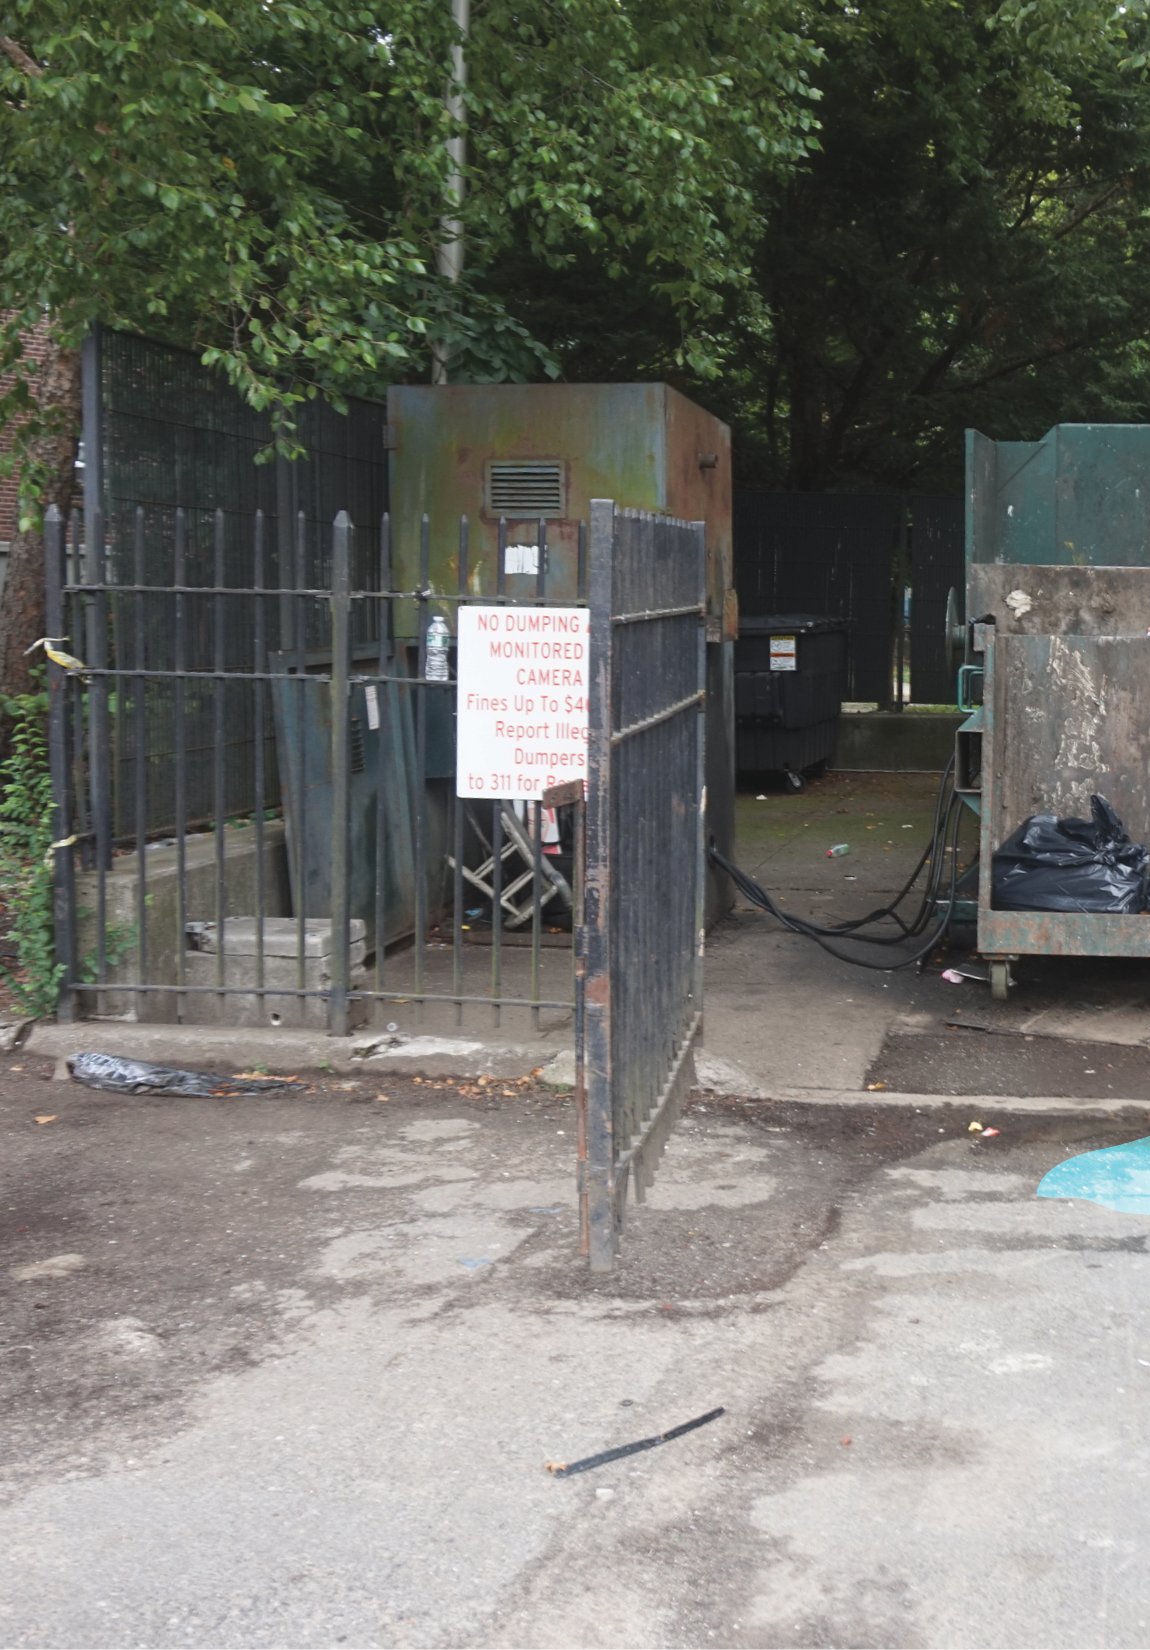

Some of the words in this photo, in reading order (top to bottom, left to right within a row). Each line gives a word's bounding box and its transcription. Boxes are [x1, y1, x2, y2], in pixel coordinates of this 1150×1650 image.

[478, 614, 499, 632] NO
[506, 615, 580, 633] DUMPING
[490, 642, 584, 660] MONITORED
[517, 668, 583, 686] CAMERA
[467, 693, 508, 711] Fines
[514, 695, 534, 715] Up
[541, 695, 559, 712] To
[496, 720, 550, 741] Report
[514, 747, 585, 769] Dumpers
[468, 773, 484, 790] to
[490, 774, 512, 791] 311
[517, 774, 540, 791] for
